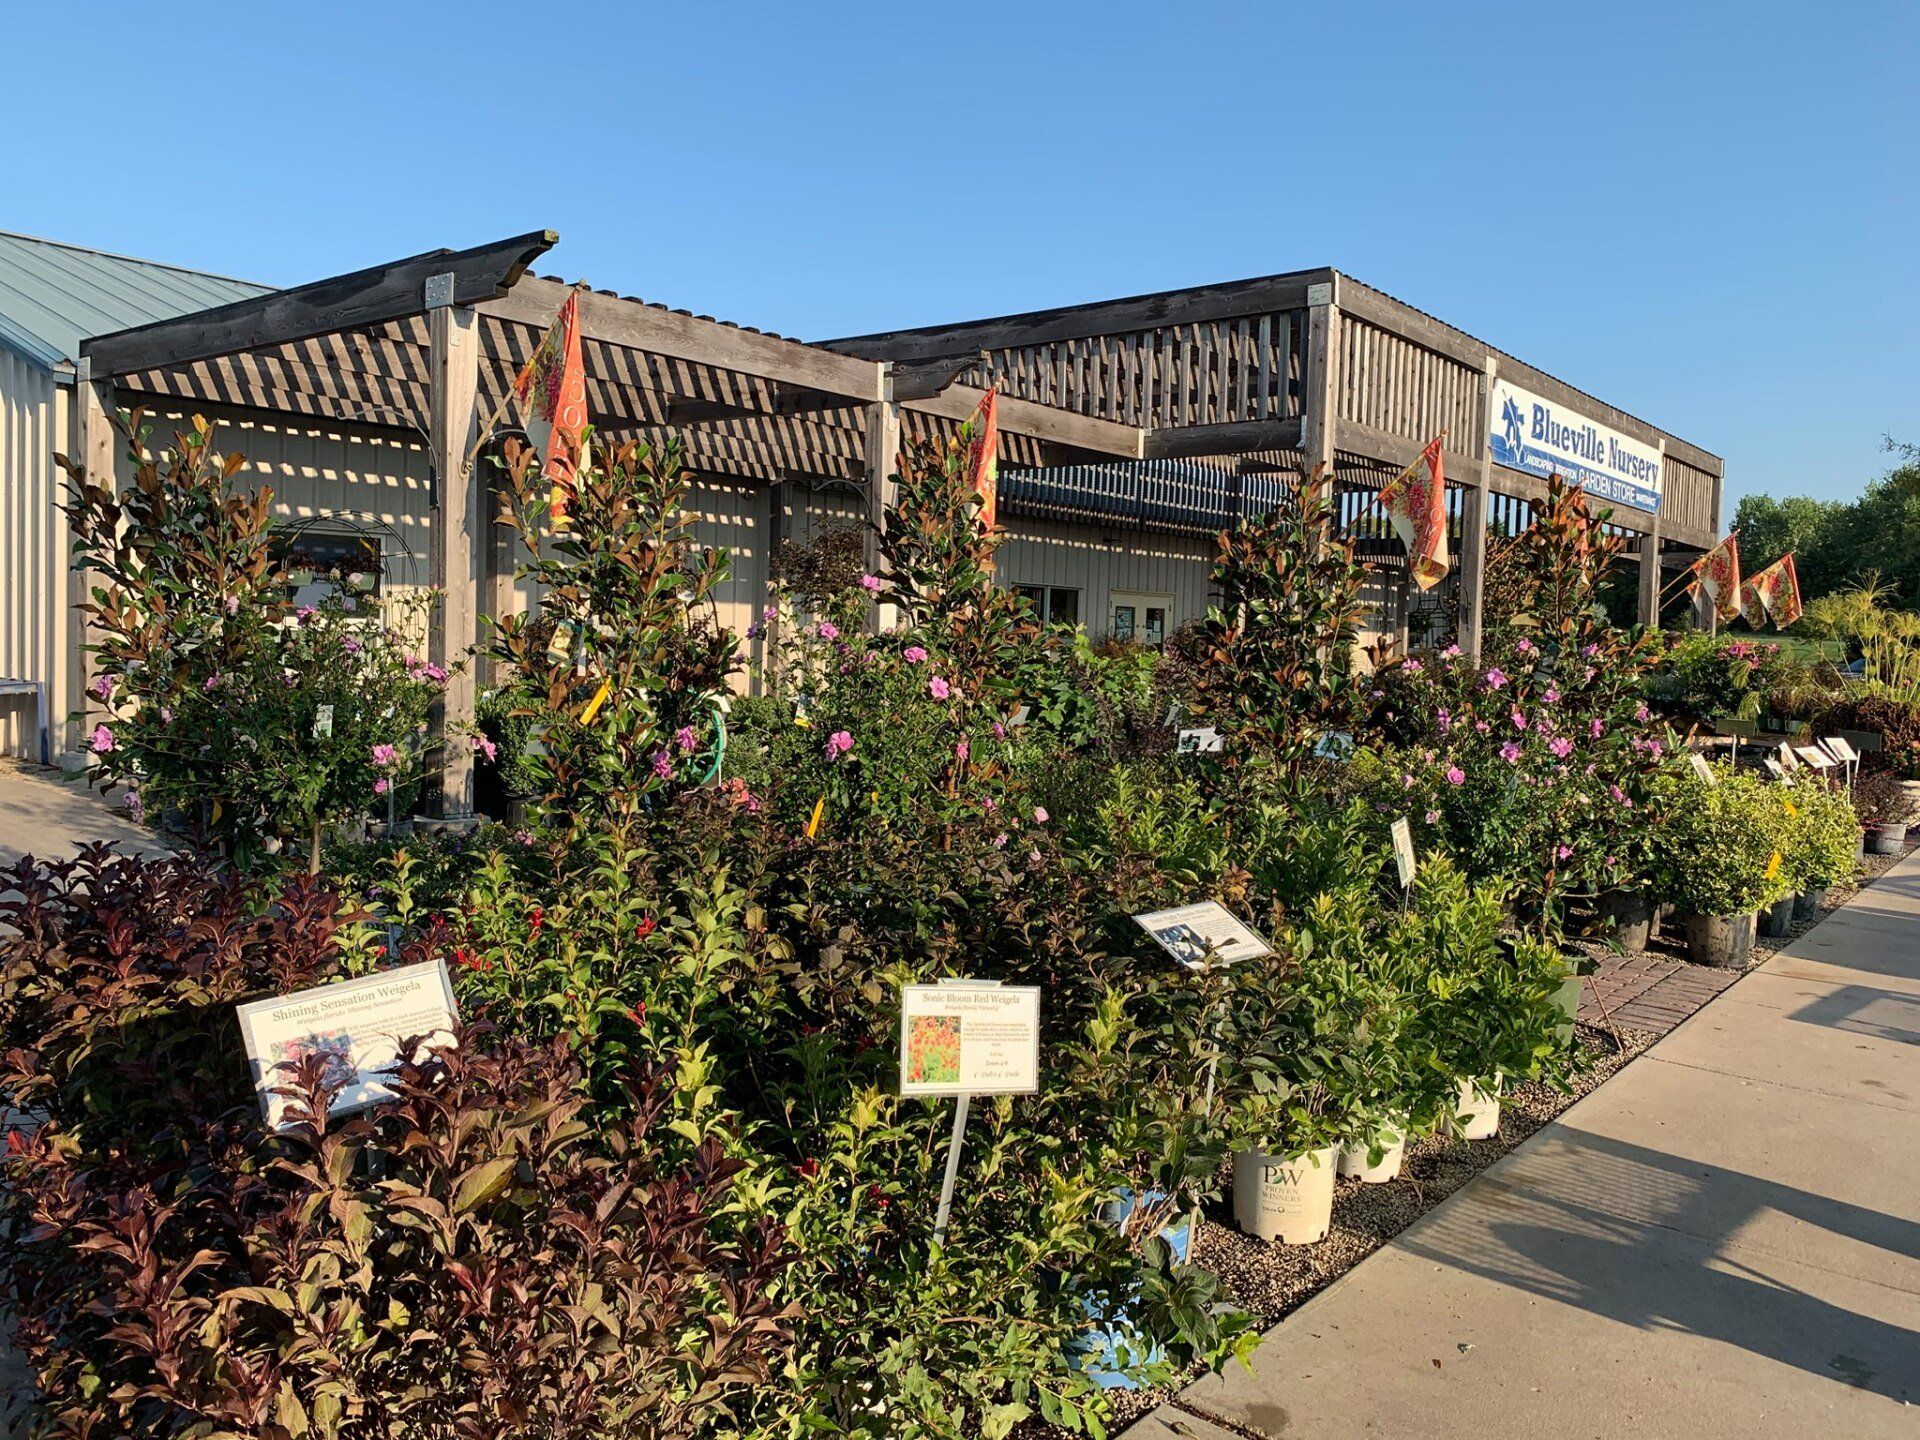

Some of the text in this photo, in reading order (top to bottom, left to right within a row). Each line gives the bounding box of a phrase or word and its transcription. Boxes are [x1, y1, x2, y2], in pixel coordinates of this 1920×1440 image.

[1531, 403, 1659, 490] Blueville Nursery
[1579, 469, 1611, 495] GARDEN
[1612, 481, 1635, 503] STORE
[272, 981, 421, 1022] Shining Sensation Weigela
[923, 993, 1020, 1006] Sonic Bloom Red Weigela
[1264, 1164, 1304, 1186] PW
[1262, 1191, 1302, 1202] WINNERS
